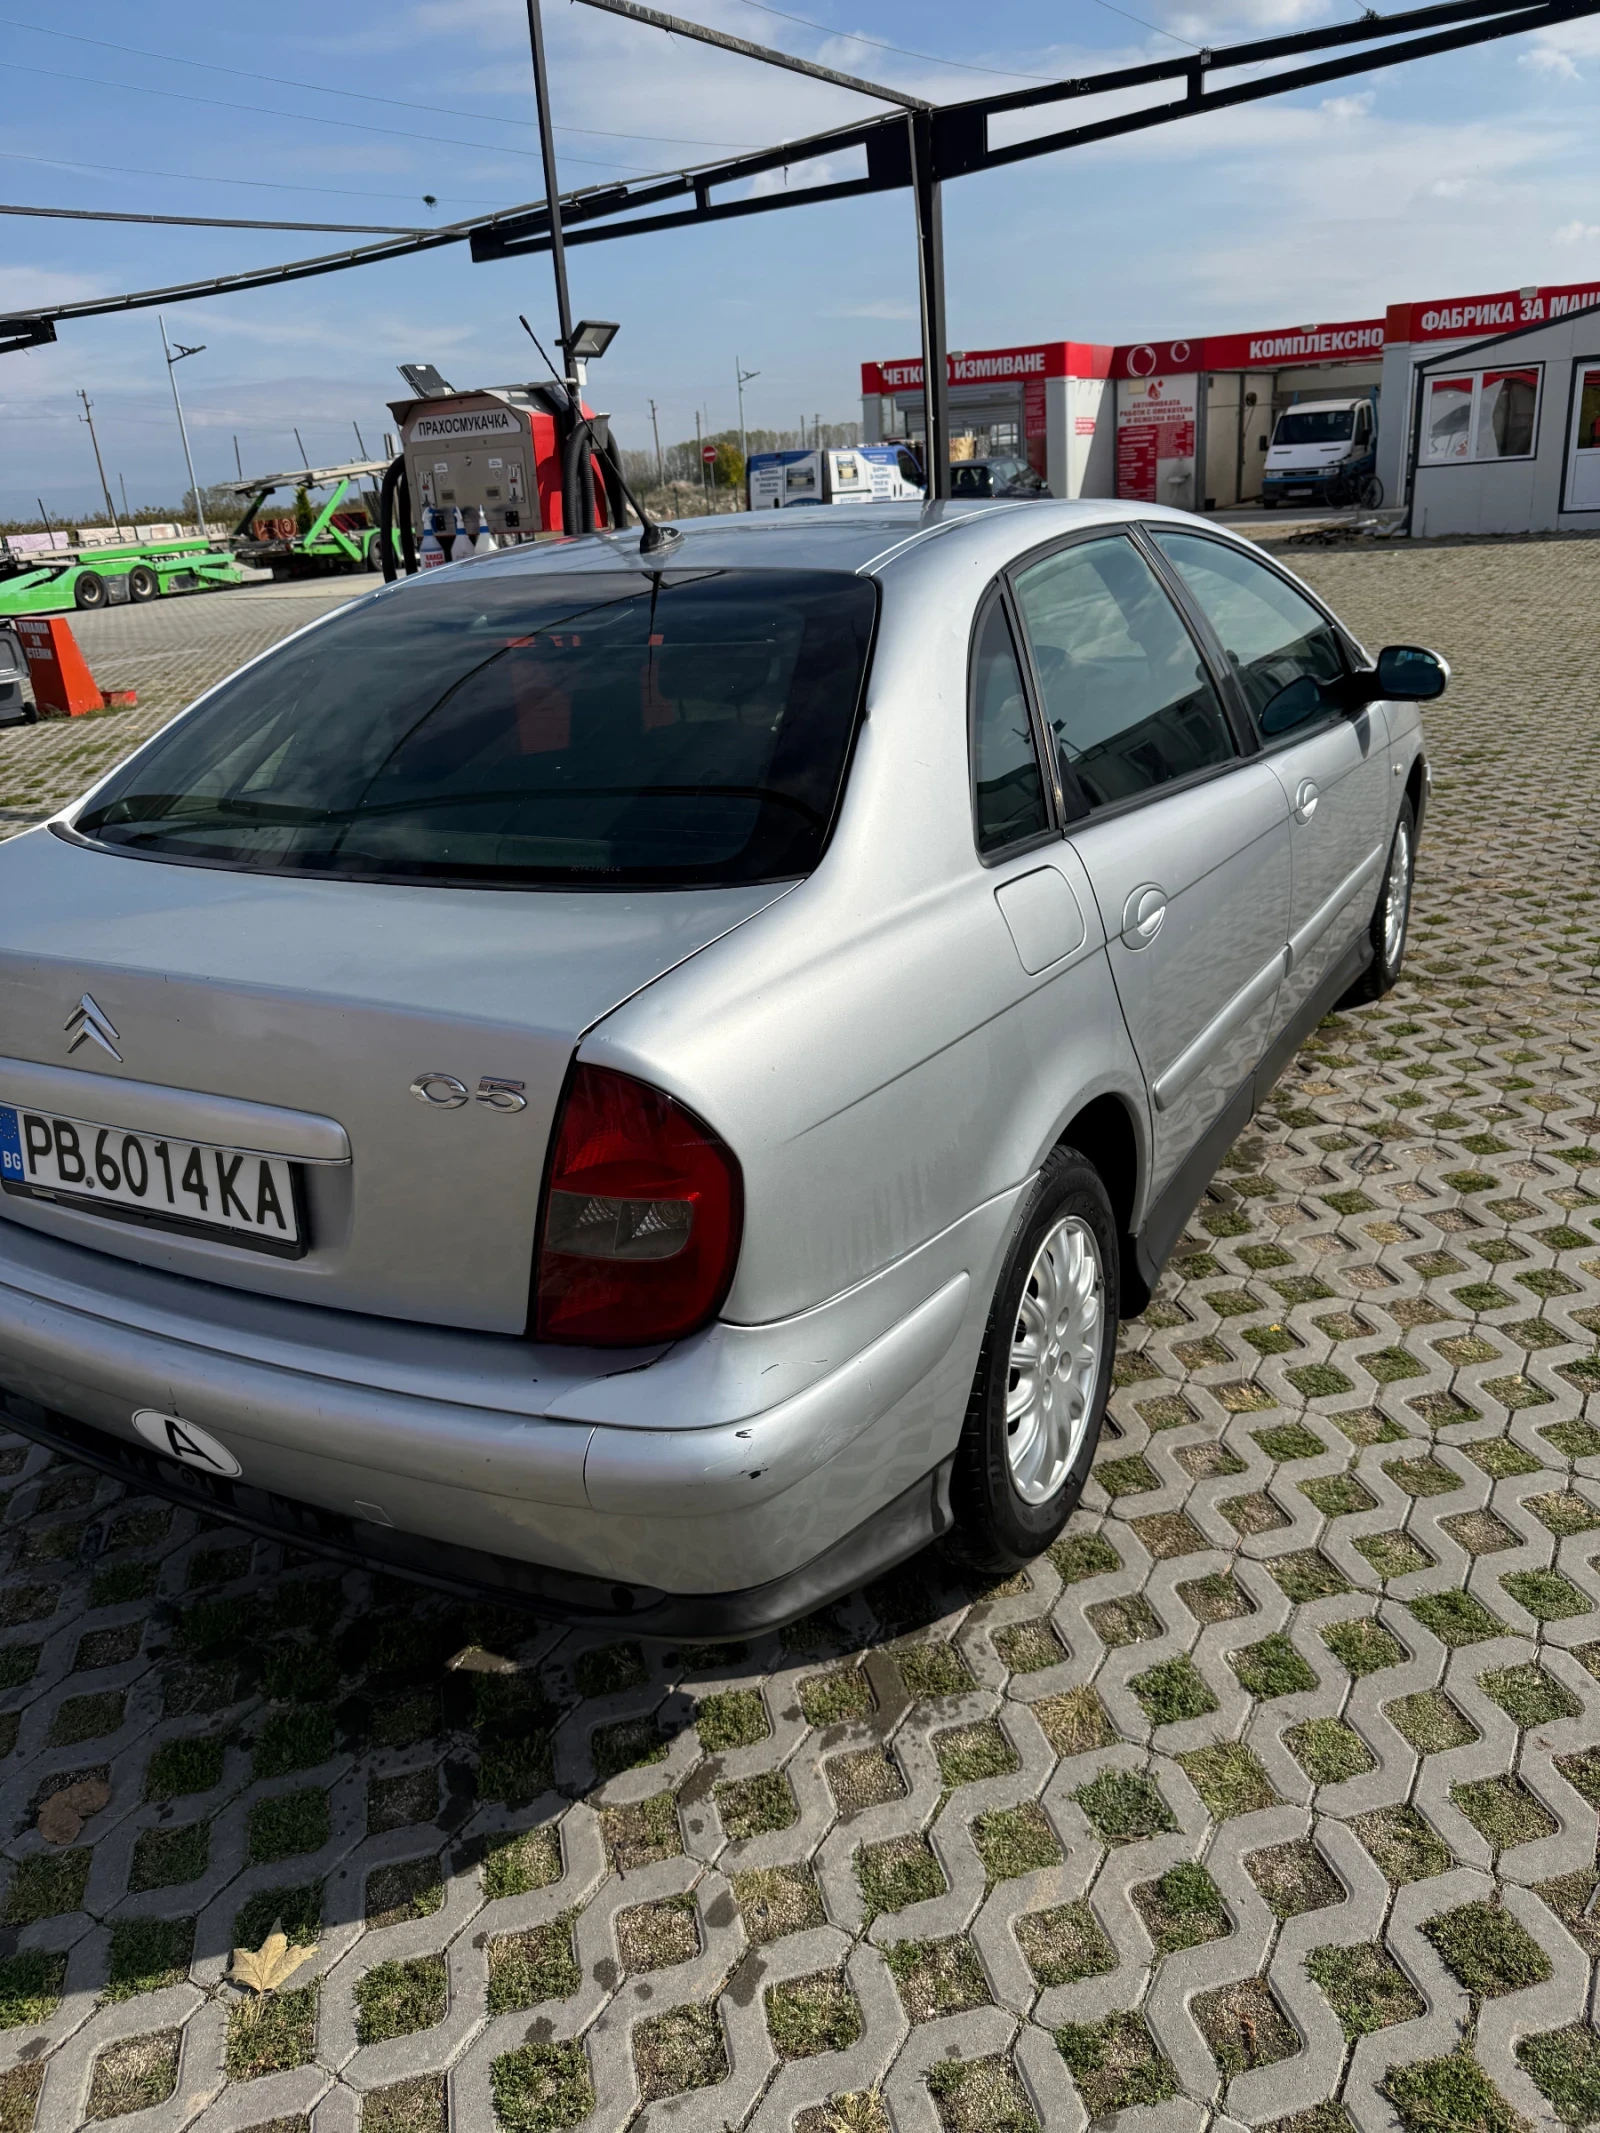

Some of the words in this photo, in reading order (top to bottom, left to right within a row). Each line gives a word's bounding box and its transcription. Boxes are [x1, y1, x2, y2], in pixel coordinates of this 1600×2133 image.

[1421, 302, 1514, 331] ФАБРИКА
[1520, 299, 1544, 320] ЗА
[1249, 328, 1384, 359] КОМПЛЕКСНО
[883, 363, 950, 385] ЧЕТК
[954, 353, 1046, 379] ИЗМИВАНЕ
[418, 413, 509, 436] ПРАХОСМУКАЧКА
[410, 1072, 527, 1113] C5
[3, 1152, 21, 1171] BG
[164, 1419, 226, 1470] A
